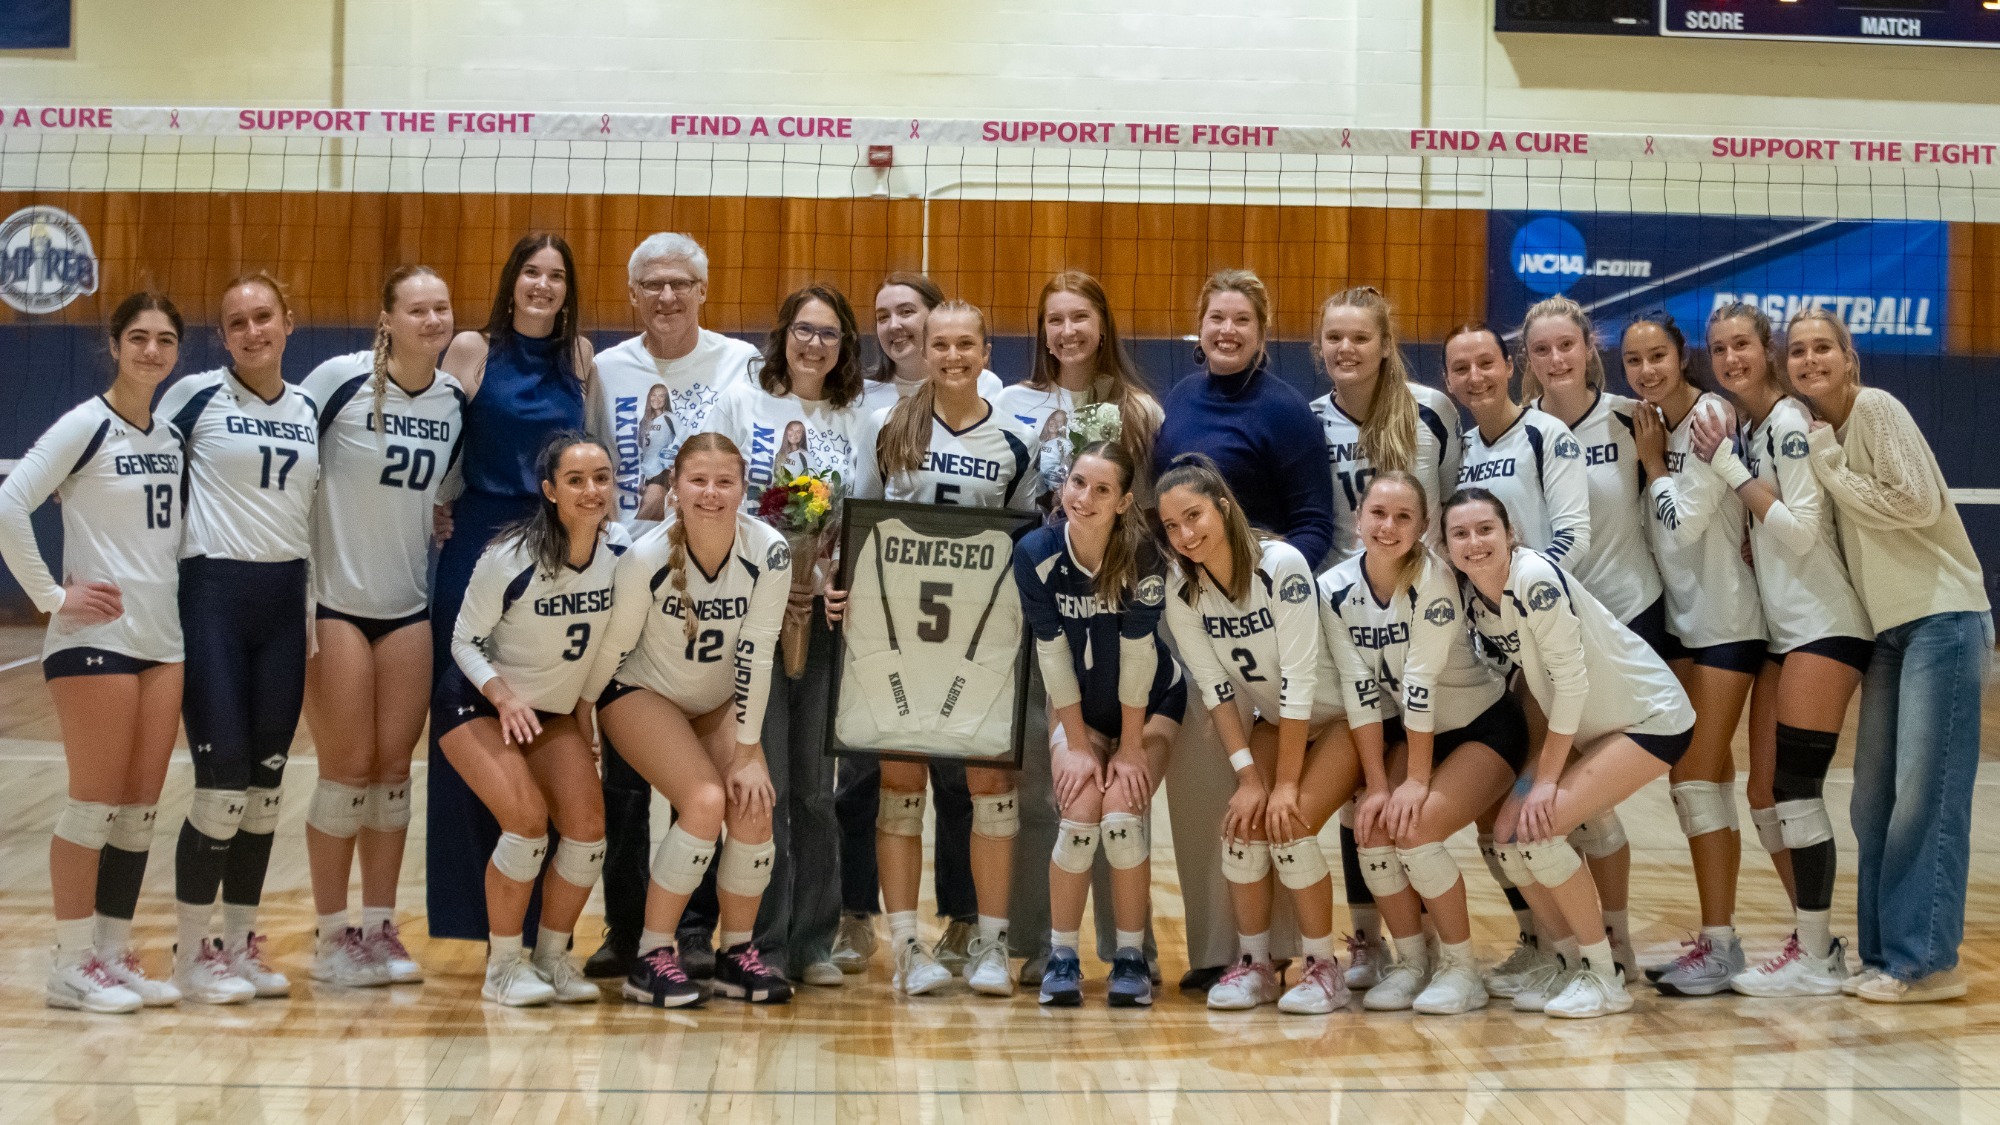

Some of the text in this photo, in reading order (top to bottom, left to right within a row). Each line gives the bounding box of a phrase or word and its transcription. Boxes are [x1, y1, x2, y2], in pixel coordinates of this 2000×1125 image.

[1686, 11, 1744, 31] SCORE
[1861, 15, 1921, 37] MATCH
[13, 108, 31, 127] A
[40, 108, 113, 128] CURE
[238, 109, 535, 133] SUPPORT THE FIGHT
[670, 115, 852, 138] FIND A CURE
[982, 121, 1279, 146] SUPPORT THE FIGHT
[1410, 130, 1588, 154] FIND A CURE
[1711, 137, 1997, 165] SUPPORT THE FIGHT
[1518, 254, 1652, 278] NCAA.com
[1709, 291, 1933, 336] SKTBALL
[226, 415, 316, 445] GENESEO
[116, 453, 179, 476] GENESEO
[258, 445, 299, 490] 17
[379, 444, 436, 491] 20
[615, 396, 640, 510] CAROLYN
[747, 421, 775, 503] OLYN
[917, 451, 1001, 482] ENESEO
[144, 484, 173, 529] 13
[884, 536, 995, 571] GENESEO
[917, 580, 953, 643] 5
[562, 622, 591, 661] 3
[685, 629, 724, 663] 12
[1231, 646, 1269, 683] 2
[888, 671, 911, 717] KNIGHTS
[940, 675, 966, 718] KNIGHTS
